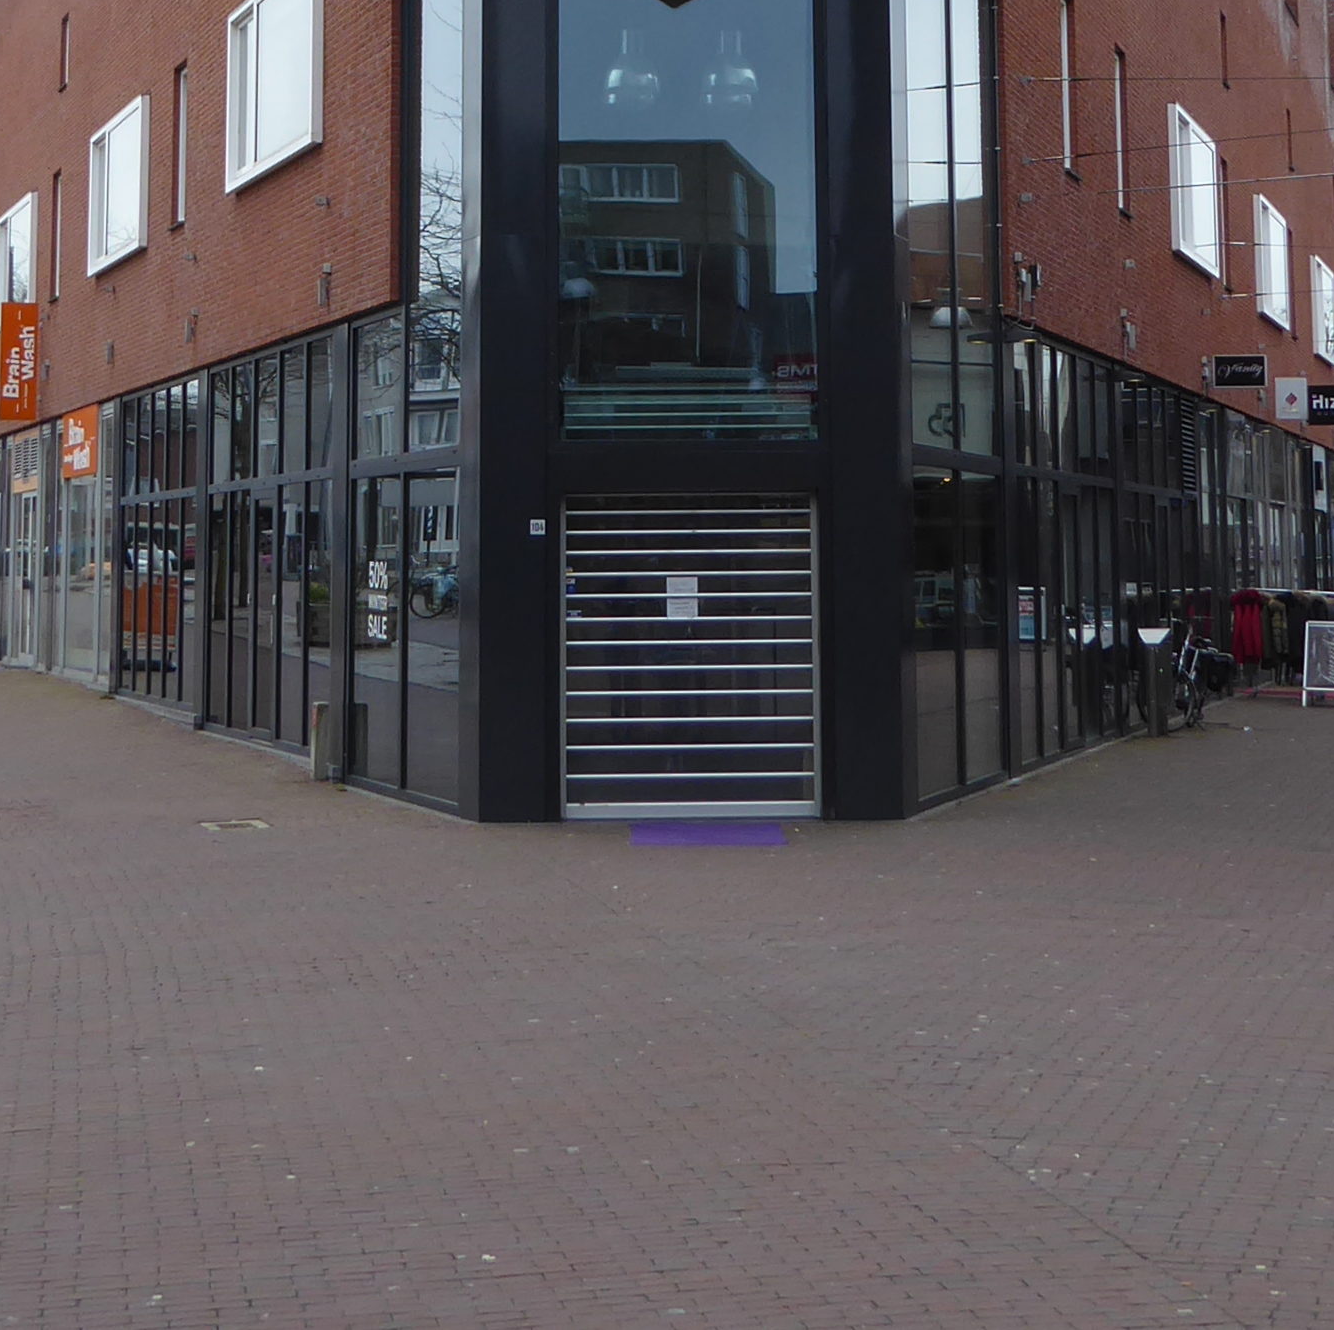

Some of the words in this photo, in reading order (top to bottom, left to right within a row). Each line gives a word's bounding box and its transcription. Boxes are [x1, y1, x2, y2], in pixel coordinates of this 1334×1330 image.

[2, 346, 20, 399] Brain
[19, 325, 36, 381] Wash
[368, 560, 389, 590] 50%
[367, 613, 388, 640] SALE
